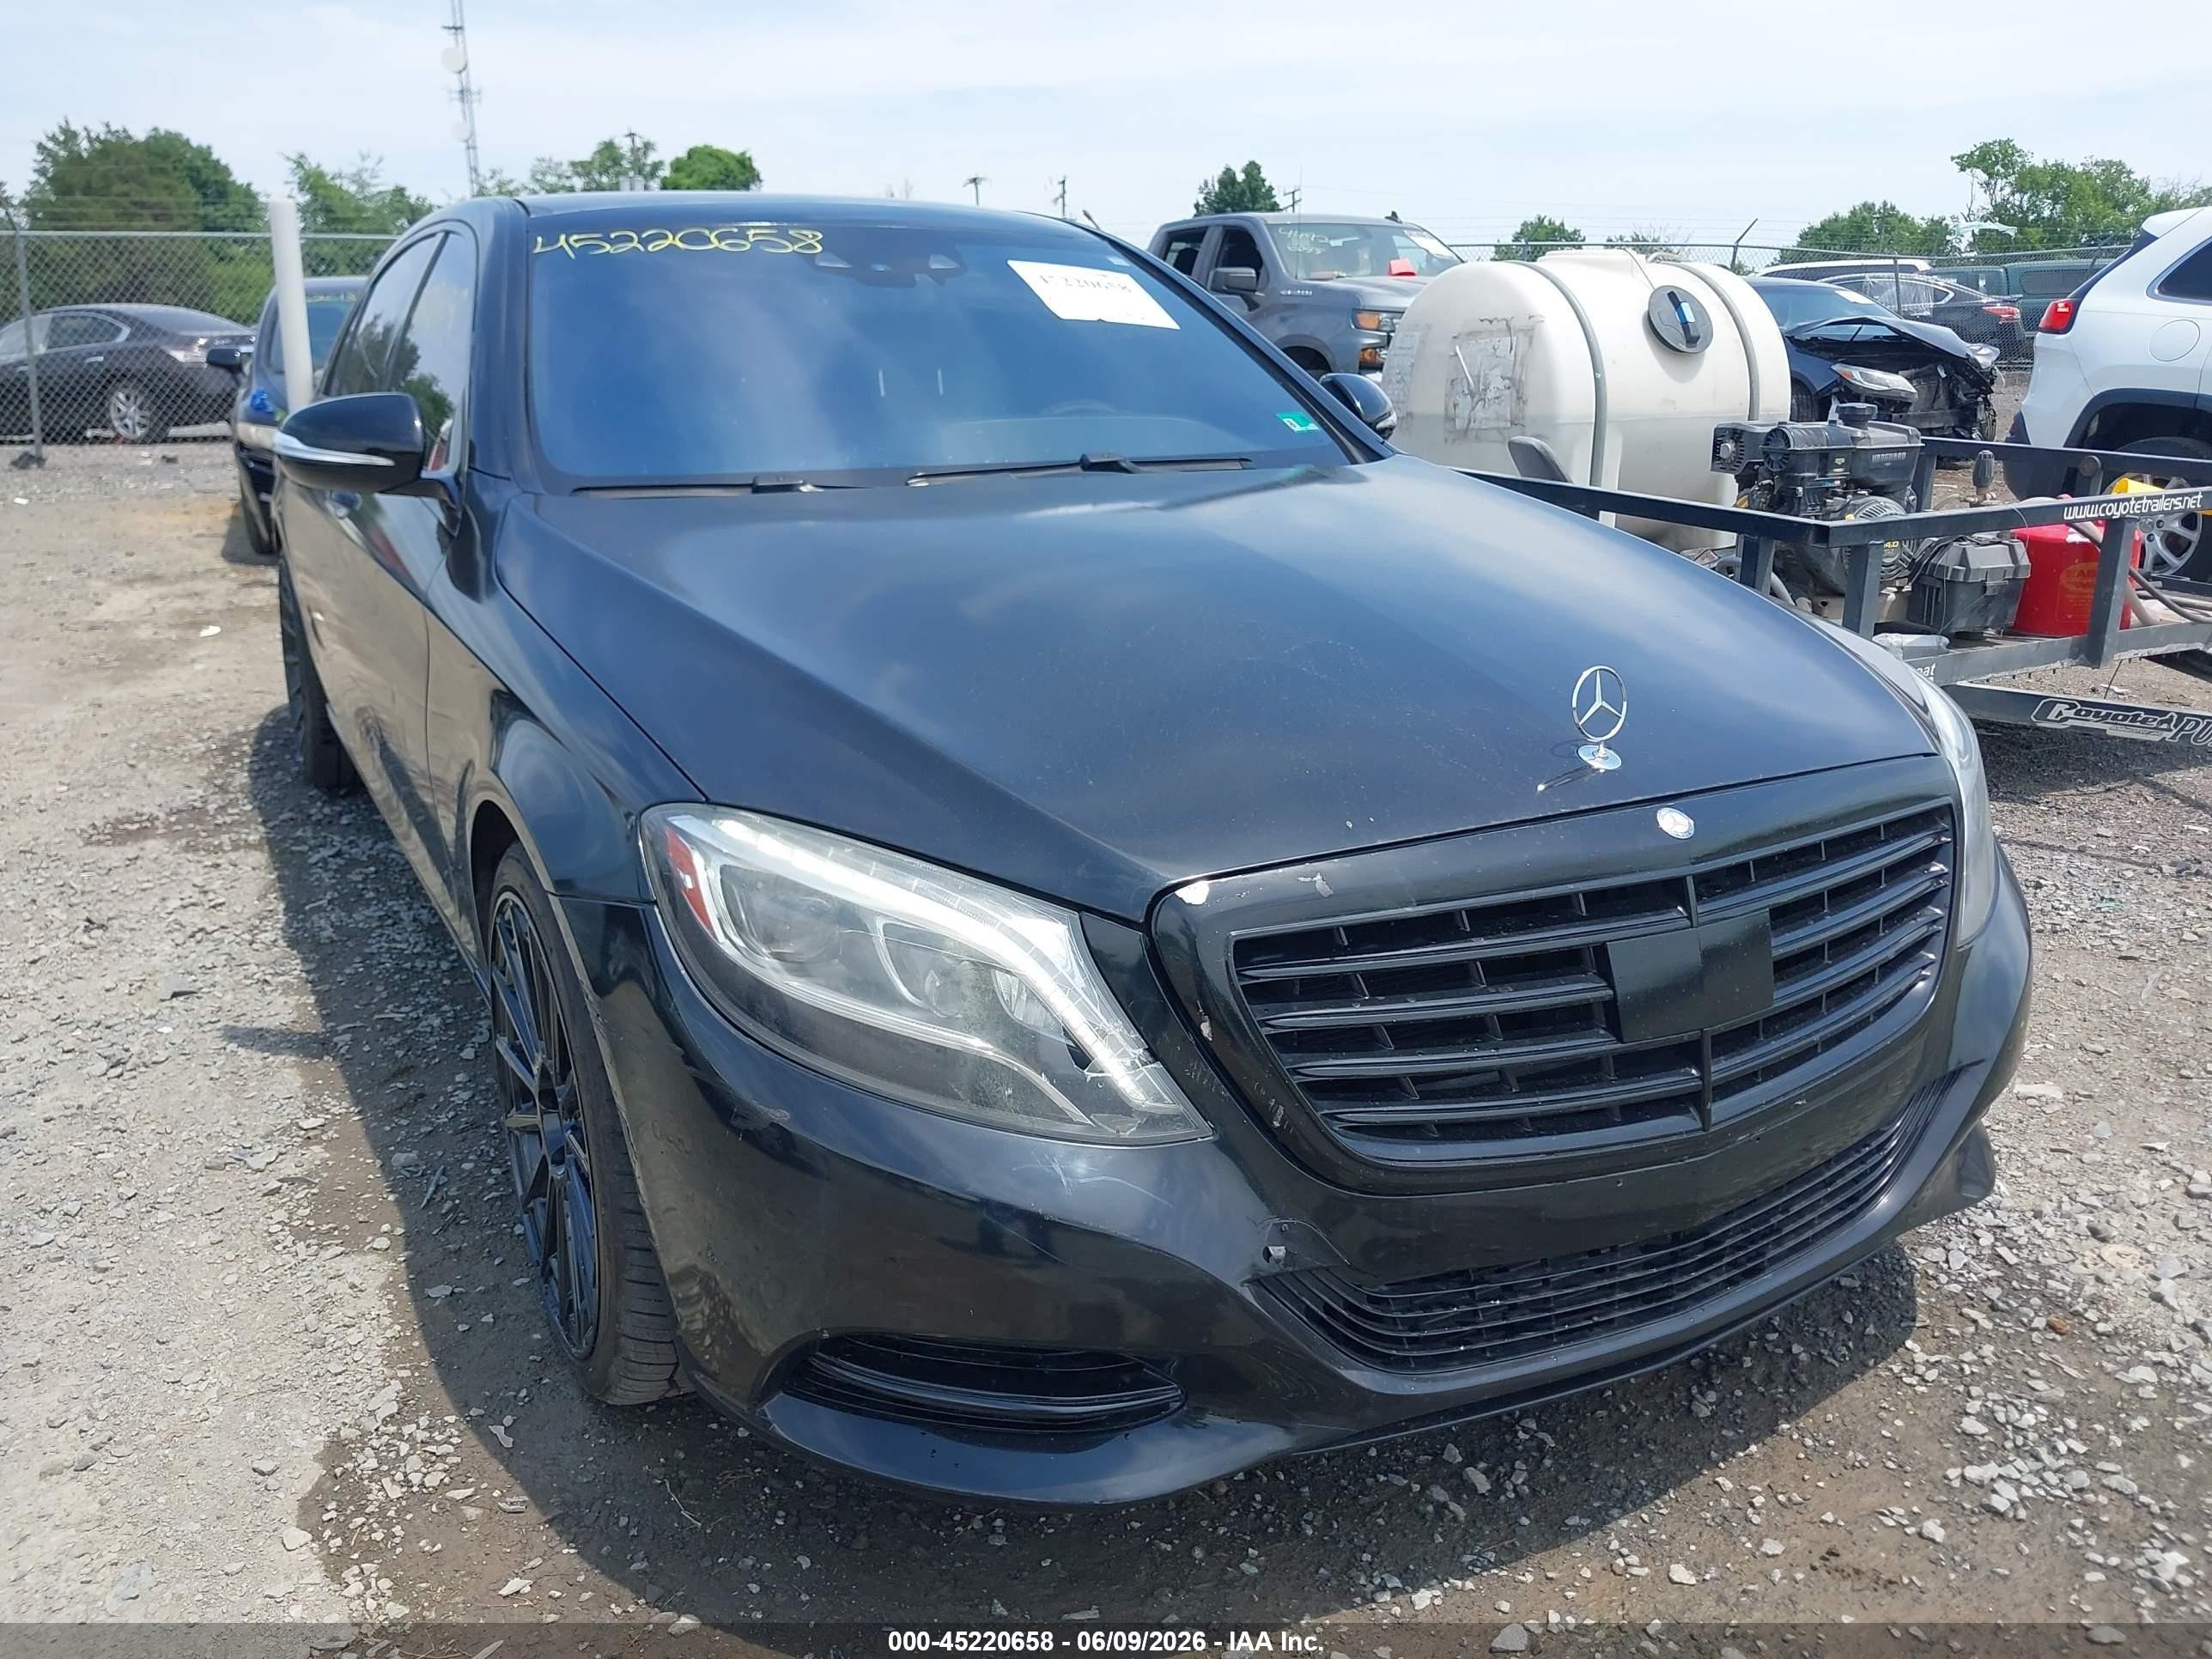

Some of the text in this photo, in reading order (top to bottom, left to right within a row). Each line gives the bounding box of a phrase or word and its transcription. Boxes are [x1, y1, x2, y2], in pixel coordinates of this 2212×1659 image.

[532, 227, 824, 259] 45220658
[2063, 491, 2203, 520] www.coyotetrailers.net
[2031, 698, 2159, 727] Coyote
